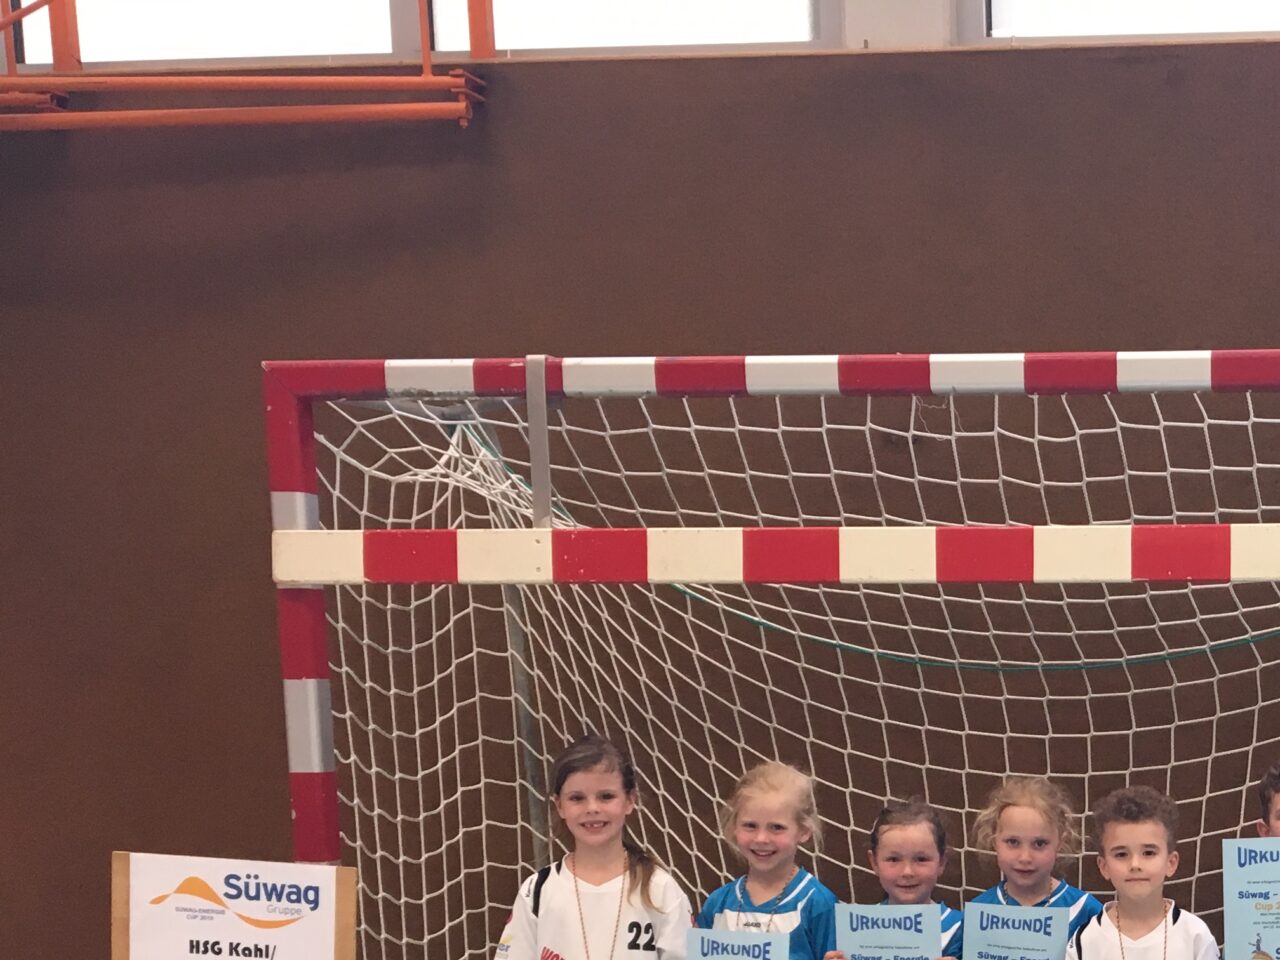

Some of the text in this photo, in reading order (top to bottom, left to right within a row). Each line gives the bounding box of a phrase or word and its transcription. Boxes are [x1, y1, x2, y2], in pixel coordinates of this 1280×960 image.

[223, 874, 320, 911] Süwag
[1238, 890, 1270, 900] Süwag
[267, 904, 302, 915] Gruppe
[1254, 902, 1274, 911] Cup
[849, 912, 923, 934] URKUNDE
[979, 910, 1053, 937] URKUNDE
[627, 921, 656, 952] 22
[189, 940, 277, 960] HSG Kahl/
